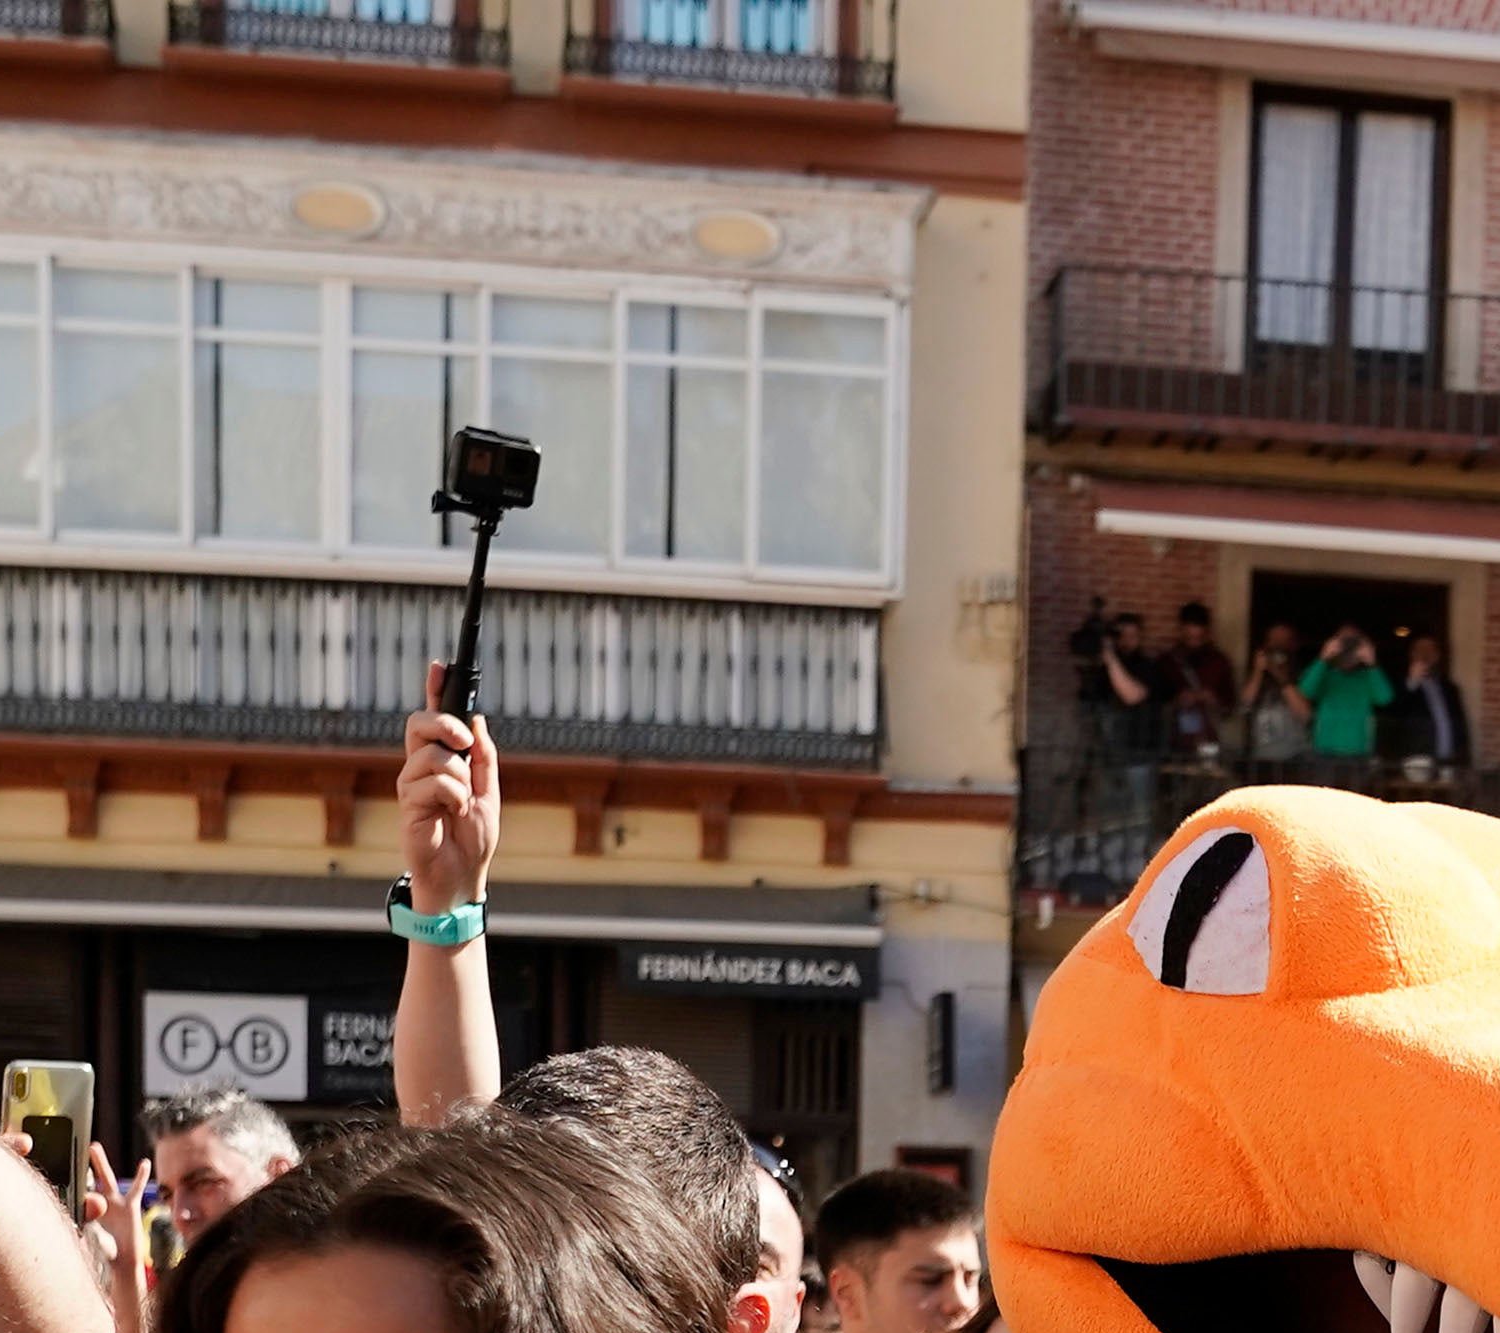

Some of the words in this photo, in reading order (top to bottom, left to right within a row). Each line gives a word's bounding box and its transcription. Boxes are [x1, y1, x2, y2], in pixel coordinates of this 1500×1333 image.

[637, 951, 783, 985] FERNÁNDEZ
[785, 959, 862, 988] BACA
[181, 1026, 198, 1062] F
[252, 1028, 274, 1064] B
